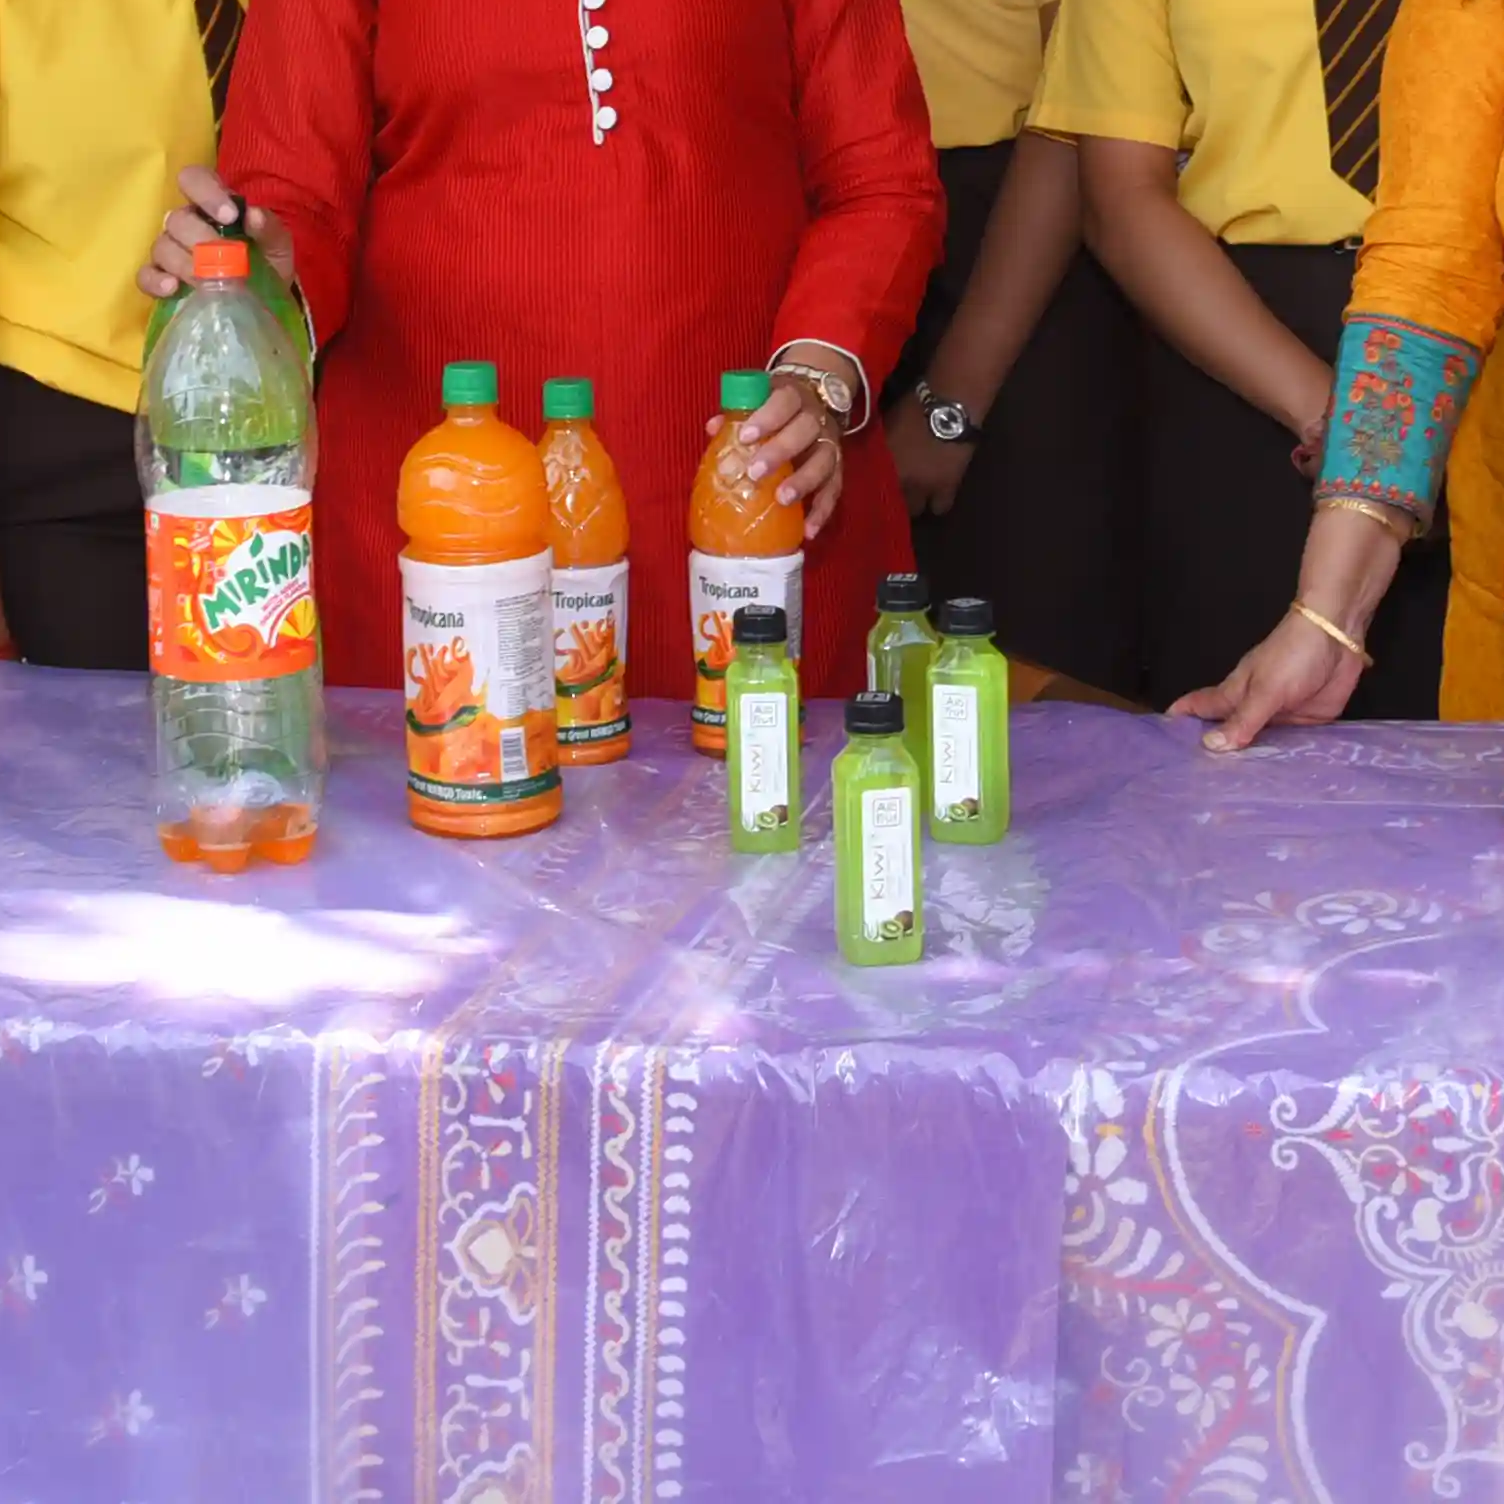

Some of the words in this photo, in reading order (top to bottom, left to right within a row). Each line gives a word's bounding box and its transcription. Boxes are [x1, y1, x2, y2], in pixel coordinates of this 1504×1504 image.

[553, 591, 614, 611] Tropicana
[699, 576, 760, 600] Tropicana
[406, 595, 465, 628] Tropicana
[407, 635, 472, 706] Slice
[870, 844, 885, 901] KIWI
